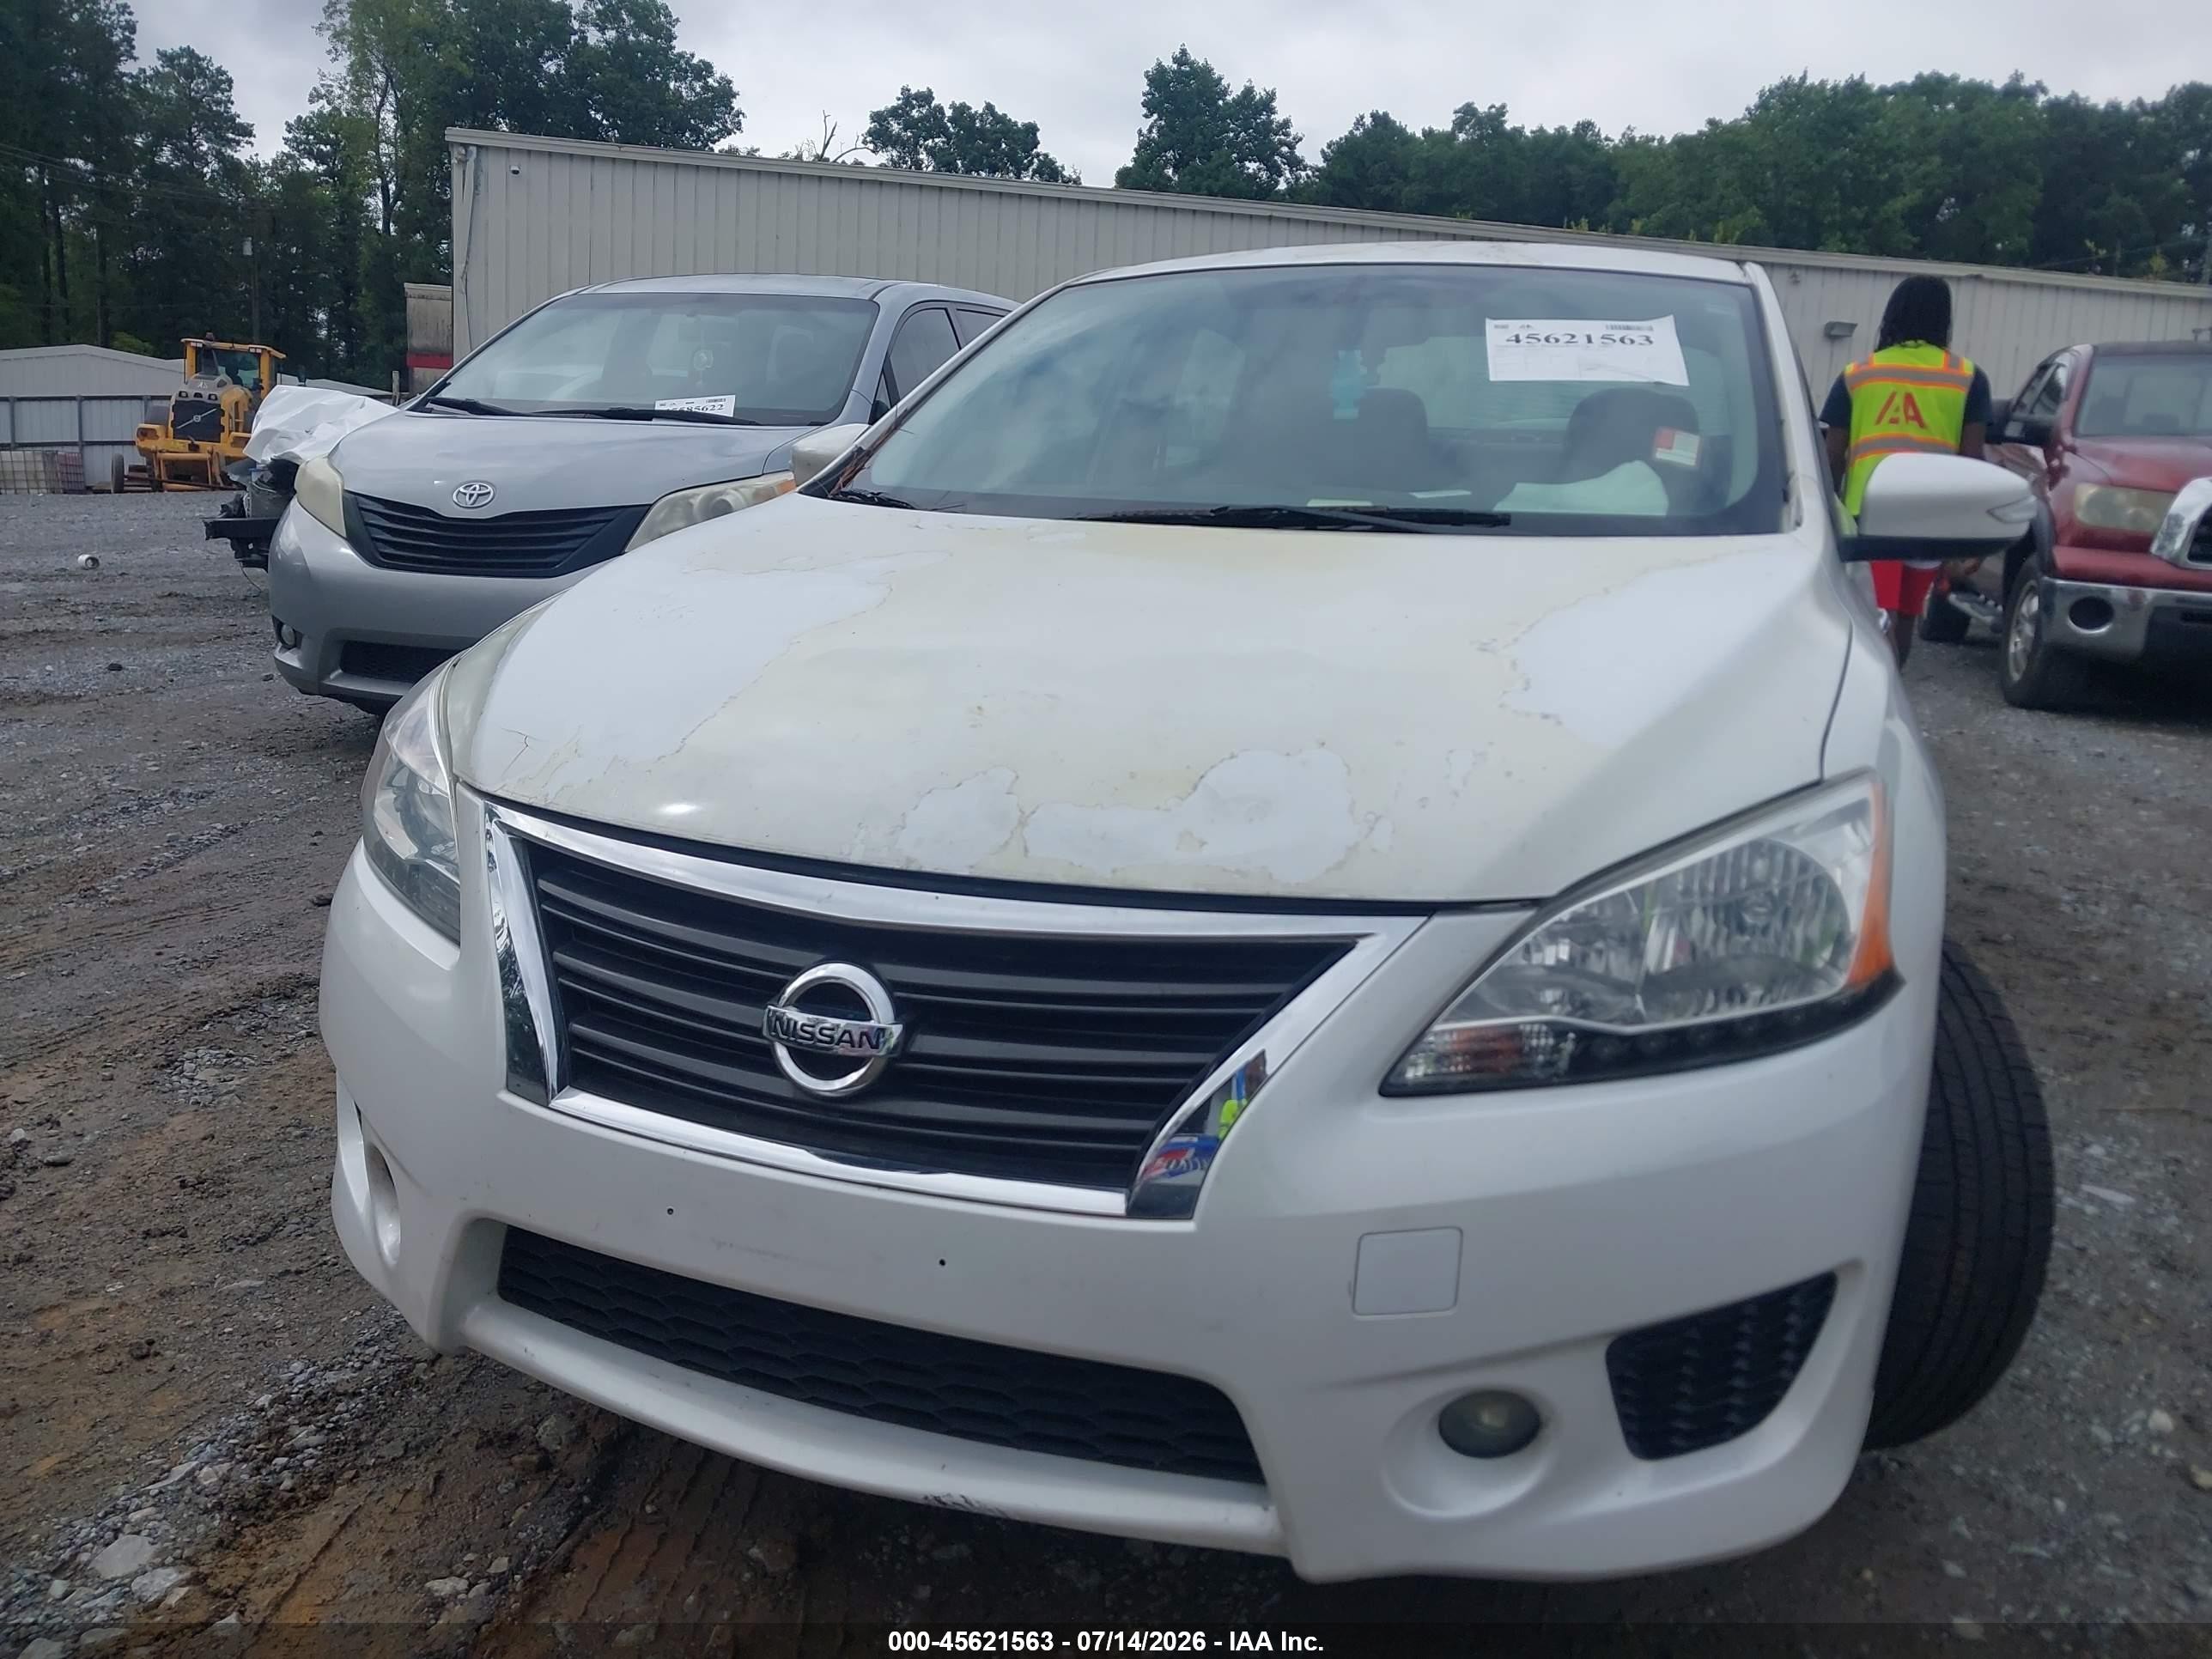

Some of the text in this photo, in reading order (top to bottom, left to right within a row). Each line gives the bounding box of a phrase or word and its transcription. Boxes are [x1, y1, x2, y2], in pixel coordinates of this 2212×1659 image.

[1505, 333, 1654, 345] 45621563
[666, 404, 724, 412] 85622
[769, 1011, 885, 1049] NISSAN
